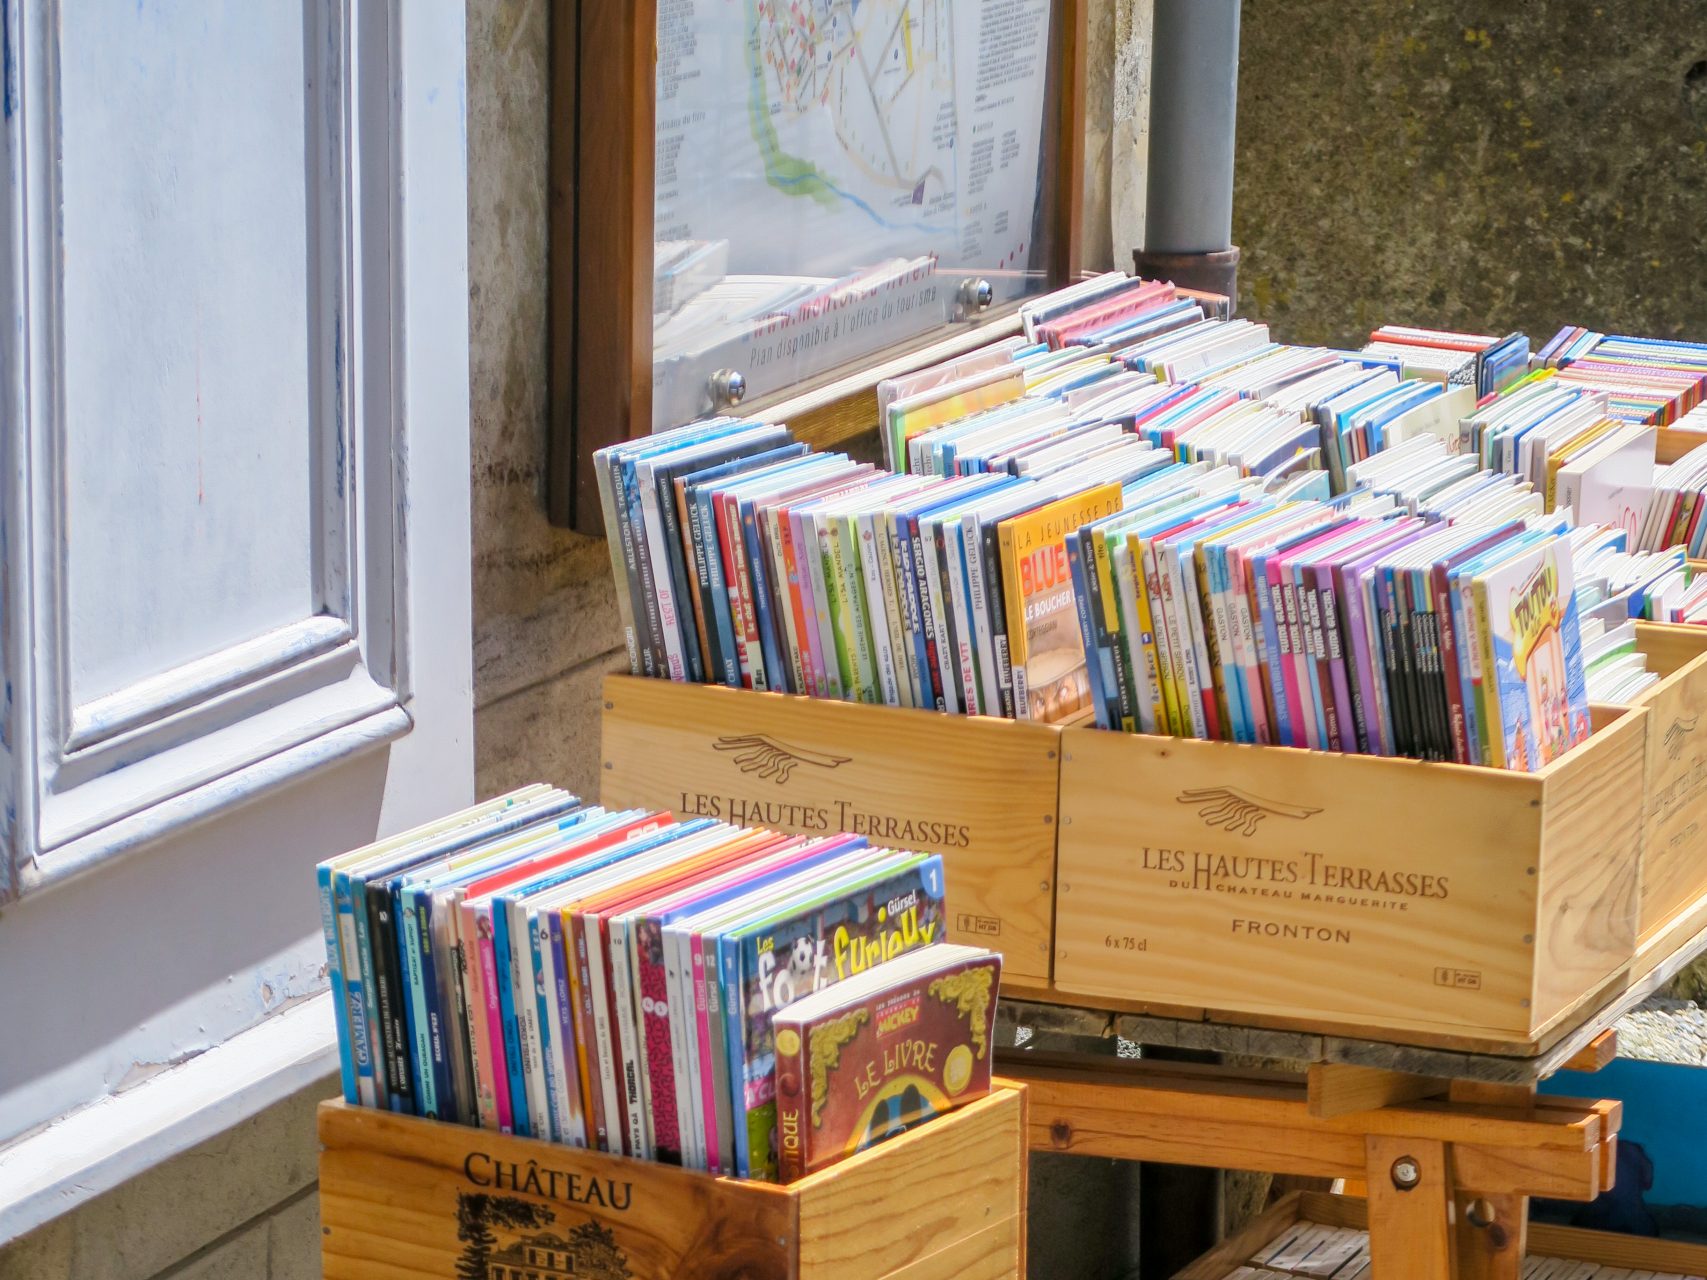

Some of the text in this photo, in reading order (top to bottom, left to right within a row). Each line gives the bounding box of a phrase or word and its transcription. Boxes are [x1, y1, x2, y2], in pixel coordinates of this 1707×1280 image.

[750, 348, 773, 369] Plan
[777, 326, 830, 360] disponible
[843, 308, 878, 335] l'office
[882, 301, 893, 318] du
[896, 285, 937, 315] tourisme
[612, 464, 625, 508] TARQUIN
[689, 503, 701, 539] GELUCK
[1016, 496, 1121, 551] LA JEUNESSE DE
[622, 521, 636, 569] ARLESTON
[700, 504, 719, 587] PHILIPPE GELUCK
[832, 542, 844, 578] MANDEL
[911, 536, 924, 576] SERGIO
[695, 541, 708, 585] PHILIPPE
[964, 526, 983, 609] PHILIPPE GELUCK
[1024, 593, 1072, 622] LE BOUCHER
[1216, 607, 1227, 641] GASTON
[1228, 603, 1239, 637] GASTON
[1239, 607, 1251, 640] GASTON
[1271, 583, 1290, 653] FLUIDE GLACIAL
[1282, 583, 1302, 653] FLUIDE GLACIAL
[1306, 588, 1326, 658] FLUIDE GLACIAL
[1321, 589, 1340, 658] FLUIDE GLACIAL
[959, 640, 969, 661] VTT
[1156, 625, 1166, 649] PETIT
[1169, 626, 1179, 648] PETIT
[724, 657, 735, 682] CHAT
[998, 638, 1011, 683] BLUEBERRY
[1159, 650, 1170, 680] SPIROU
[1173, 649, 1184, 681] SPIROU
[1015, 669, 1027, 714] BLUEBERRY
[680, 792, 971, 849] LES HAUTES TERRASSES
[929, 867, 938, 893] 1
[1142, 847, 1450, 900] LES HAUTES TERRASSES
[887, 890, 917, 918] Gürsel
[1169, 879, 1410, 912] DU CHATEAU MARGUERITE
[756, 934, 774, 954] Les
[1123, 936, 1136, 950] 75
[1138, 939, 1147, 951] cl
[1231, 918, 1352, 945] FRONTON
[694, 979, 708, 1011] Gürsel
[706, 980, 720, 1012] Gürsel
[724, 983, 739, 1015] Gürsel
[876, 1005, 920, 1037] MICKEY
[855, 1039, 939, 1100] LE LIVRE
[632, 1127, 642, 1150] PAYS
[464, 1152, 633, 1211] CHÂTEAU
